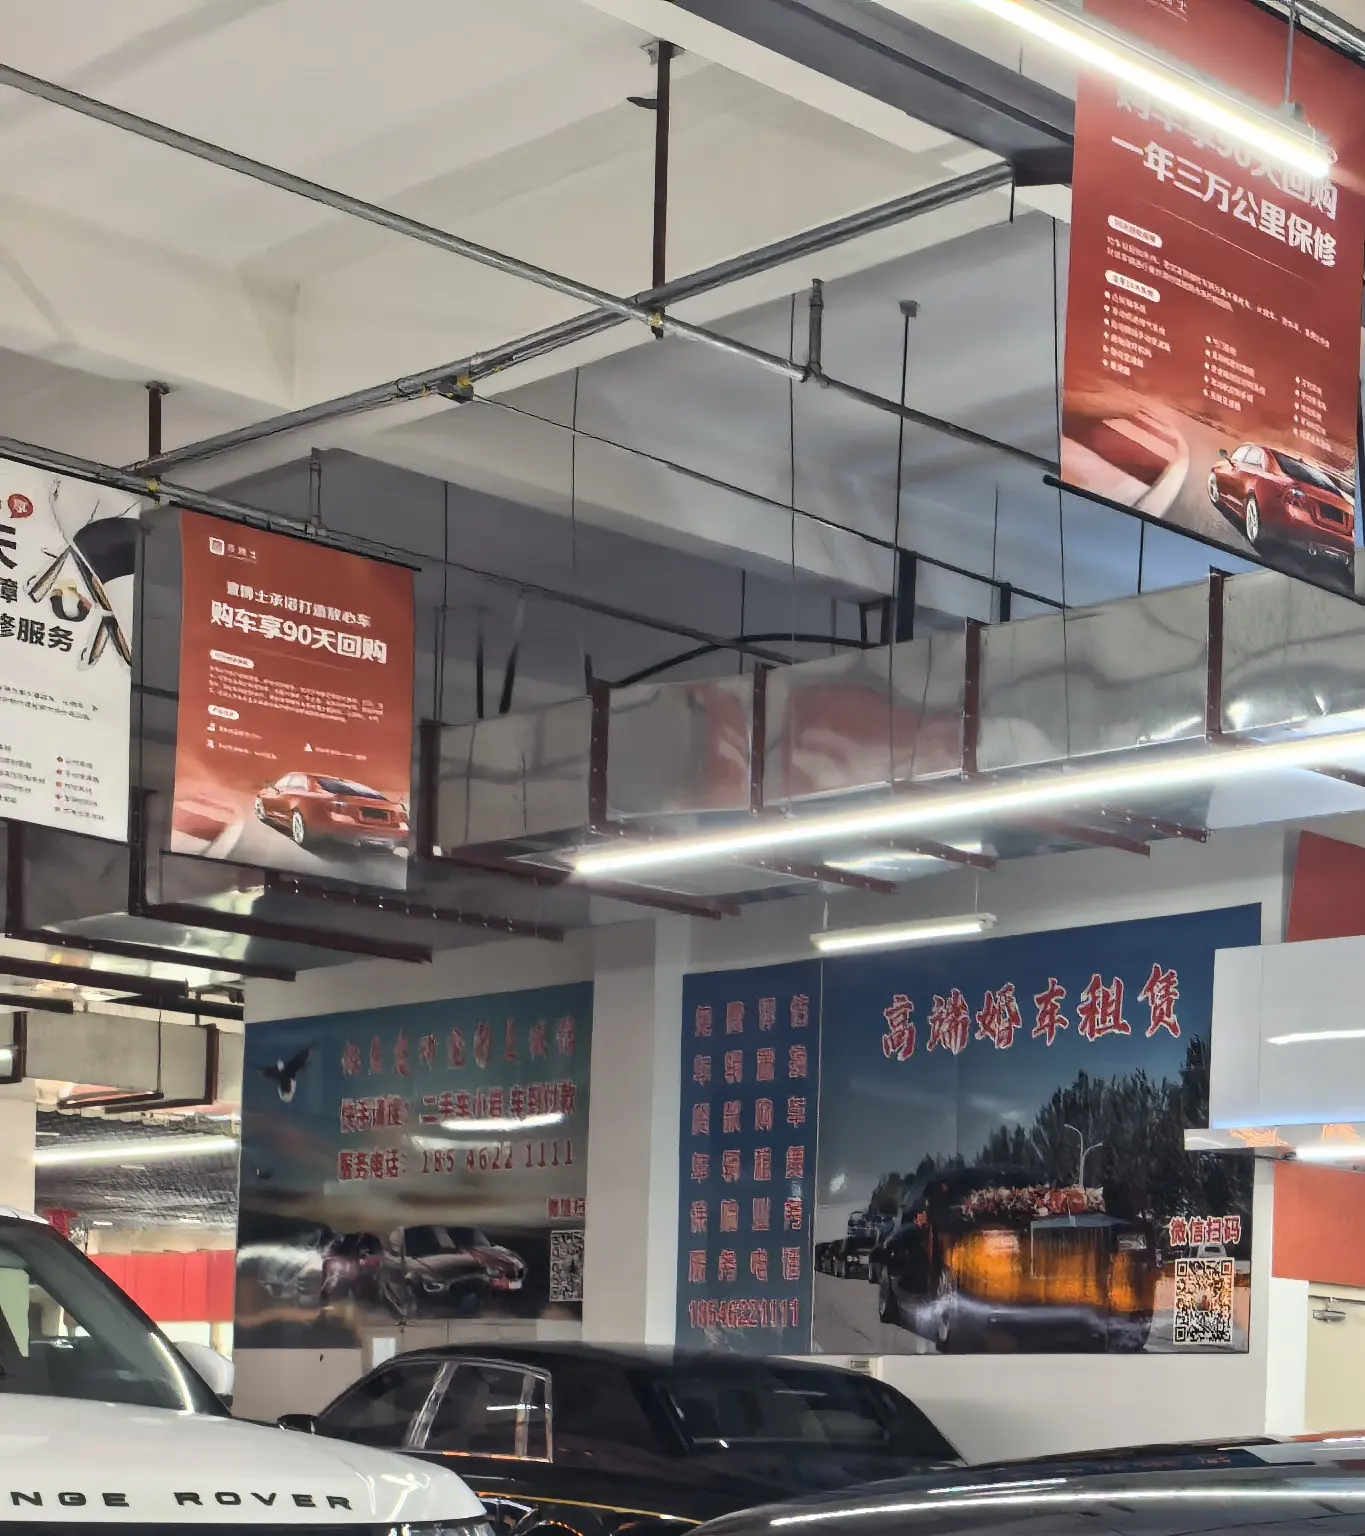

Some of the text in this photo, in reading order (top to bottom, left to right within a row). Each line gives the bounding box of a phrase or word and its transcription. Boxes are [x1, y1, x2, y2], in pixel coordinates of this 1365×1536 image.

[1111, 135, 1337, 268] 一年三万公里保修
[211, 599, 388, 665] 购车享90天回购
[882, 962, 1181, 1063] 高端婚车租赁
[525, 1139, 574, 1168] 1111
[1169, 1215, 1242, 1247] 微信扫码
[172, 1491, 354, 1511] ROVER
